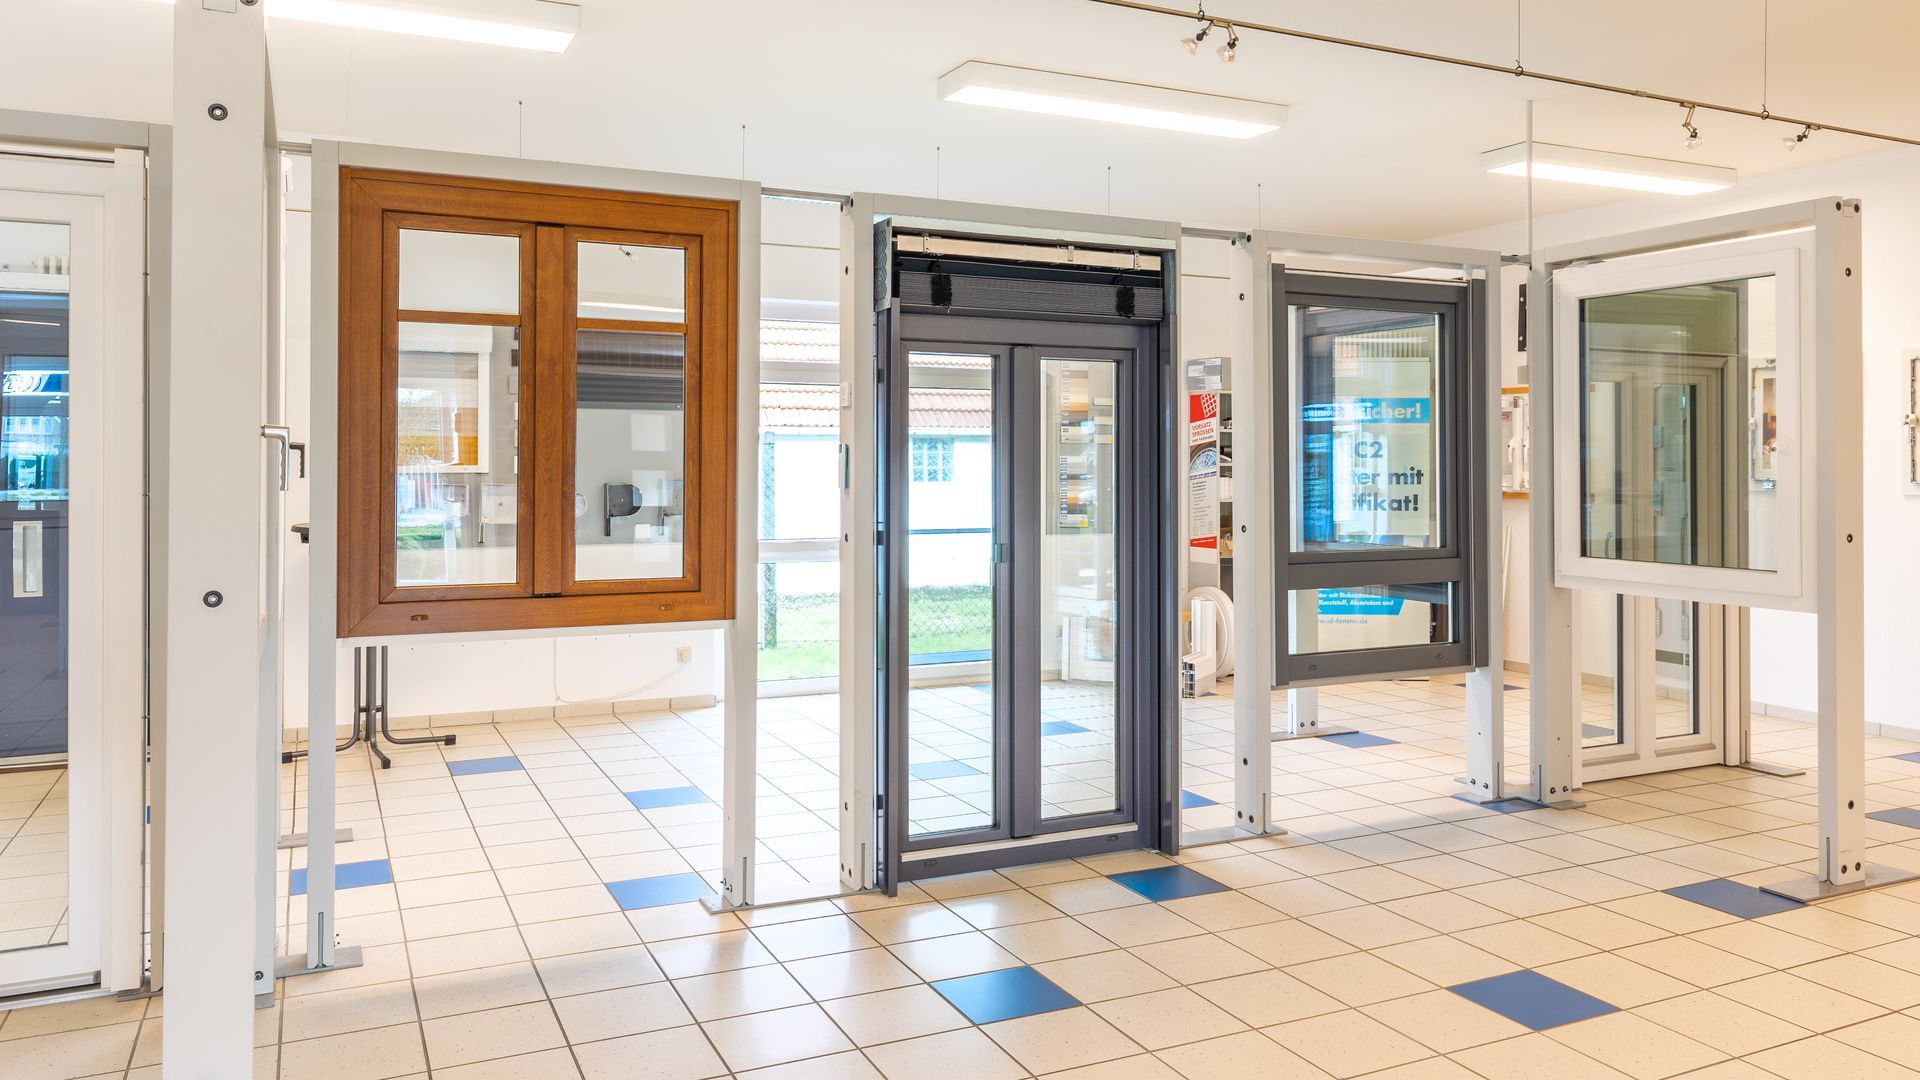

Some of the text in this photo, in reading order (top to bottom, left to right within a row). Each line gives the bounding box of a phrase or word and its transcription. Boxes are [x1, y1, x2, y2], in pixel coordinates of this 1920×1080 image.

[1360, 402, 1421, 420] sicher!
[1192, 428, 1214, 437] SPROSSEN
[1354, 440, 1384, 459] C2
[1351, 466, 1424, 485] ter mit
[1352, 492, 1419, 512] ifikat!
